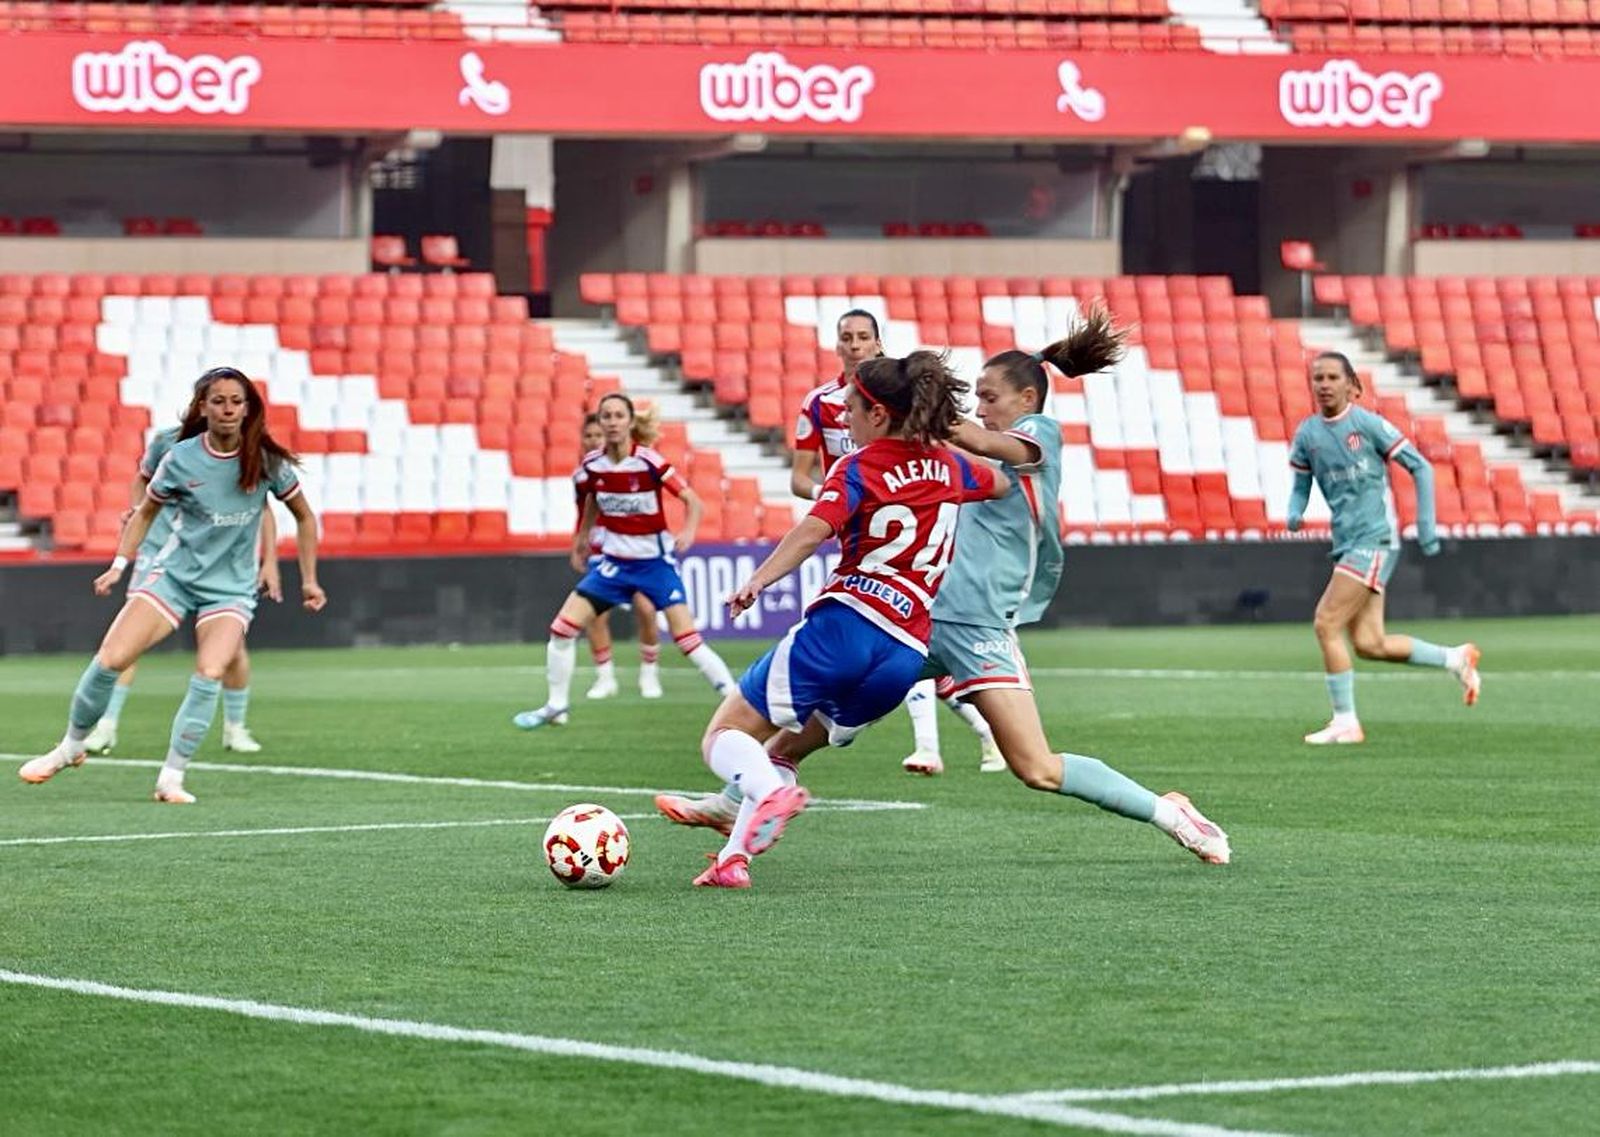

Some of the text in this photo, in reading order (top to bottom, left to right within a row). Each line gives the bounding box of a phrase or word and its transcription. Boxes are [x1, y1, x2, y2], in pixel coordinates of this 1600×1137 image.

[76, 43, 258, 112] wiber
[703, 55, 872, 119] wiber
[1282, 62, 1440, 125] wiber
[882, 459, 951, 493] ALEXIA
[857, 502, 959, 587] 24
[668, 555, 763, 630] OPA
[844, 573, 913, 618] PULEVA
